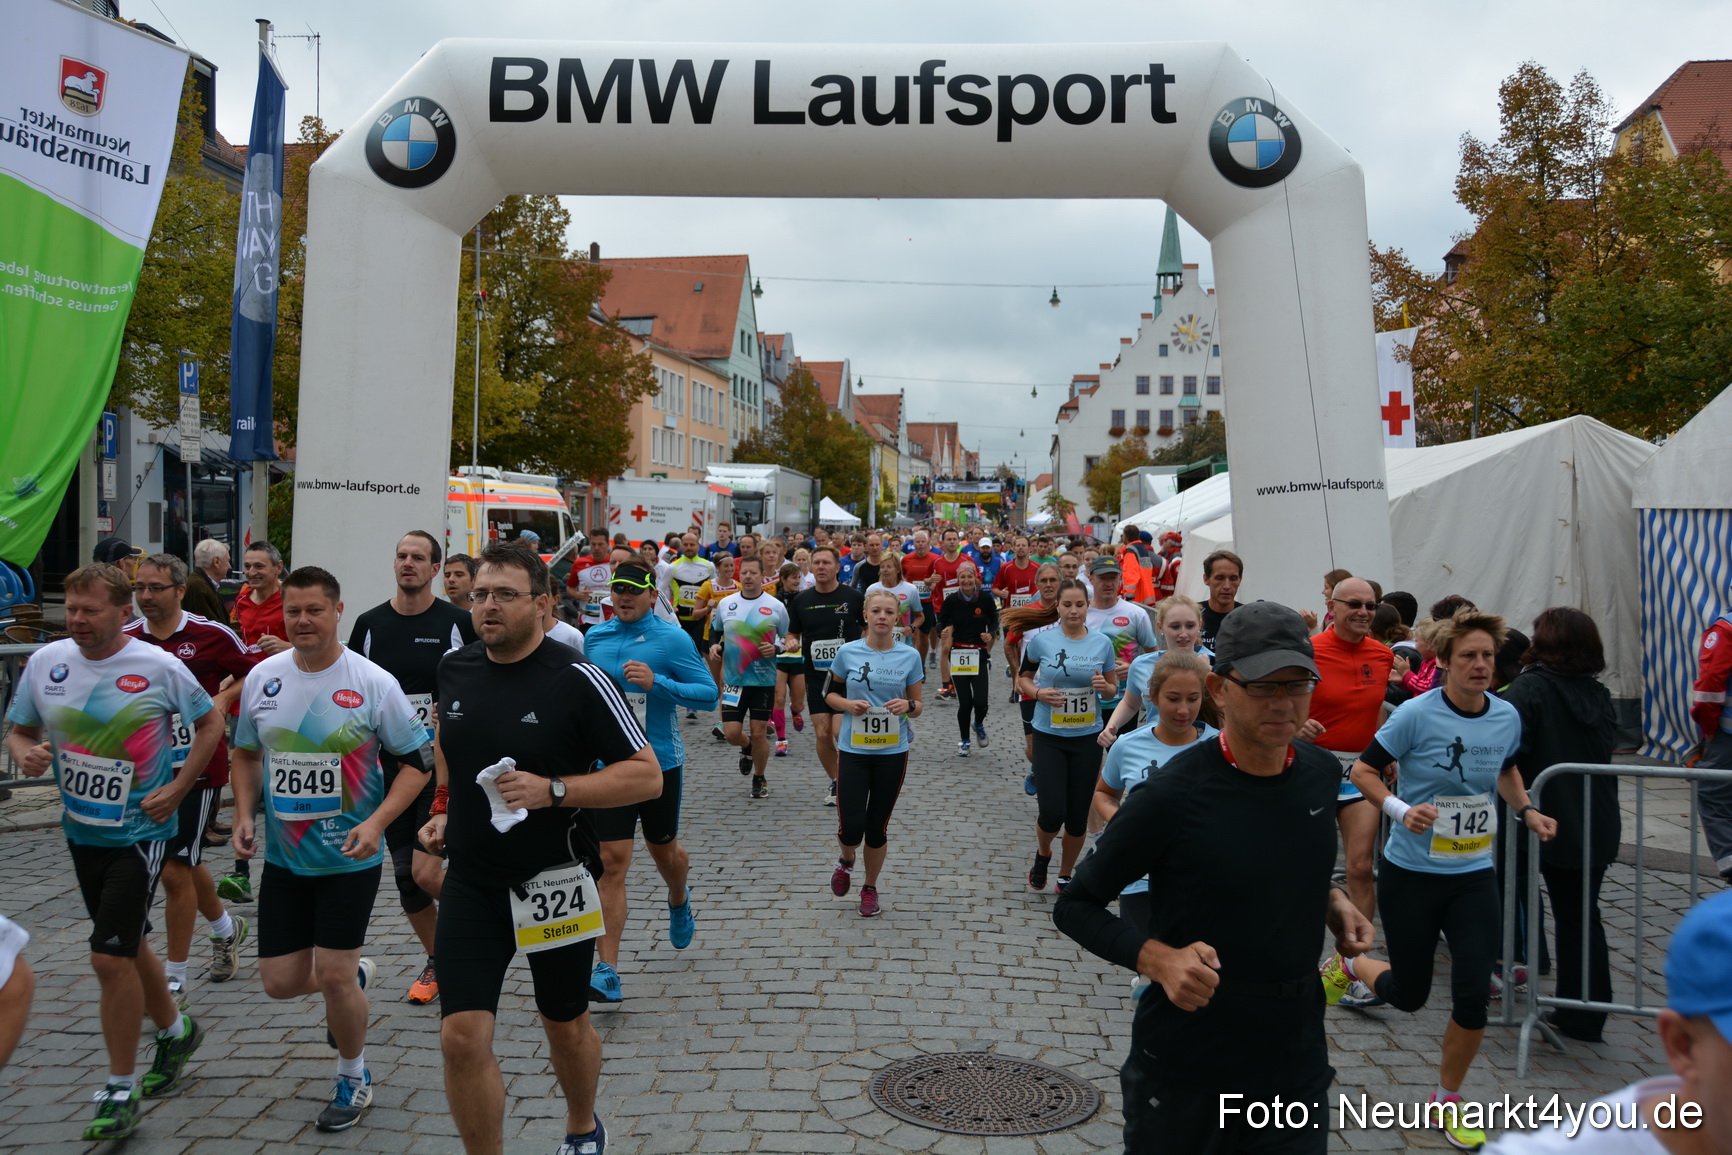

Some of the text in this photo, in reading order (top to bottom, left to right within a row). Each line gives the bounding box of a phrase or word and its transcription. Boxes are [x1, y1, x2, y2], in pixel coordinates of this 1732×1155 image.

[488, 56, 1177, 142] BMW Laufsport
[377, 98, 449, 129] BMW
[1216, 98, 1292, 129] BMW
[236, 416, 256, 431] rail
[106, 419, 114, 454] P
[136, 474, 143, 489] 3
[296, 478, 420, 495] www.bmw-laufsport.de
[1256, 477, 1384, 496] www.bmw-laufsport.de
[959, 655, 970, 665] 61
[876, 668, 893, 676] GYM
[44, 685, 67, 693] PARTL
[120, 676, 146, 689] Hervis
[336, 692, 361, 704] Hervis
[861, 717, 889, 733] 191
[863, 736, 887, 744] Sandra
[1470, 745, 1491, 756] GYM
[81, 761, 119, 773] Neumarkt
[271, 757, 328, 767] PARTL Neumarkt
[63, 767, 123, 801] 2086
[275, 768, 336, 795] 2649
[293, 801, 312, 811] Jan
[1435, 801, 1461, 809] PARTL
[320, 818, 340, 831] 16.
[1450, 810, 1489, 836] 142
[523, 873, 585, 891] RTL Neumarkt
[530, 884, 586, 922] 324
[543, 923, 580, 940] Stefan
